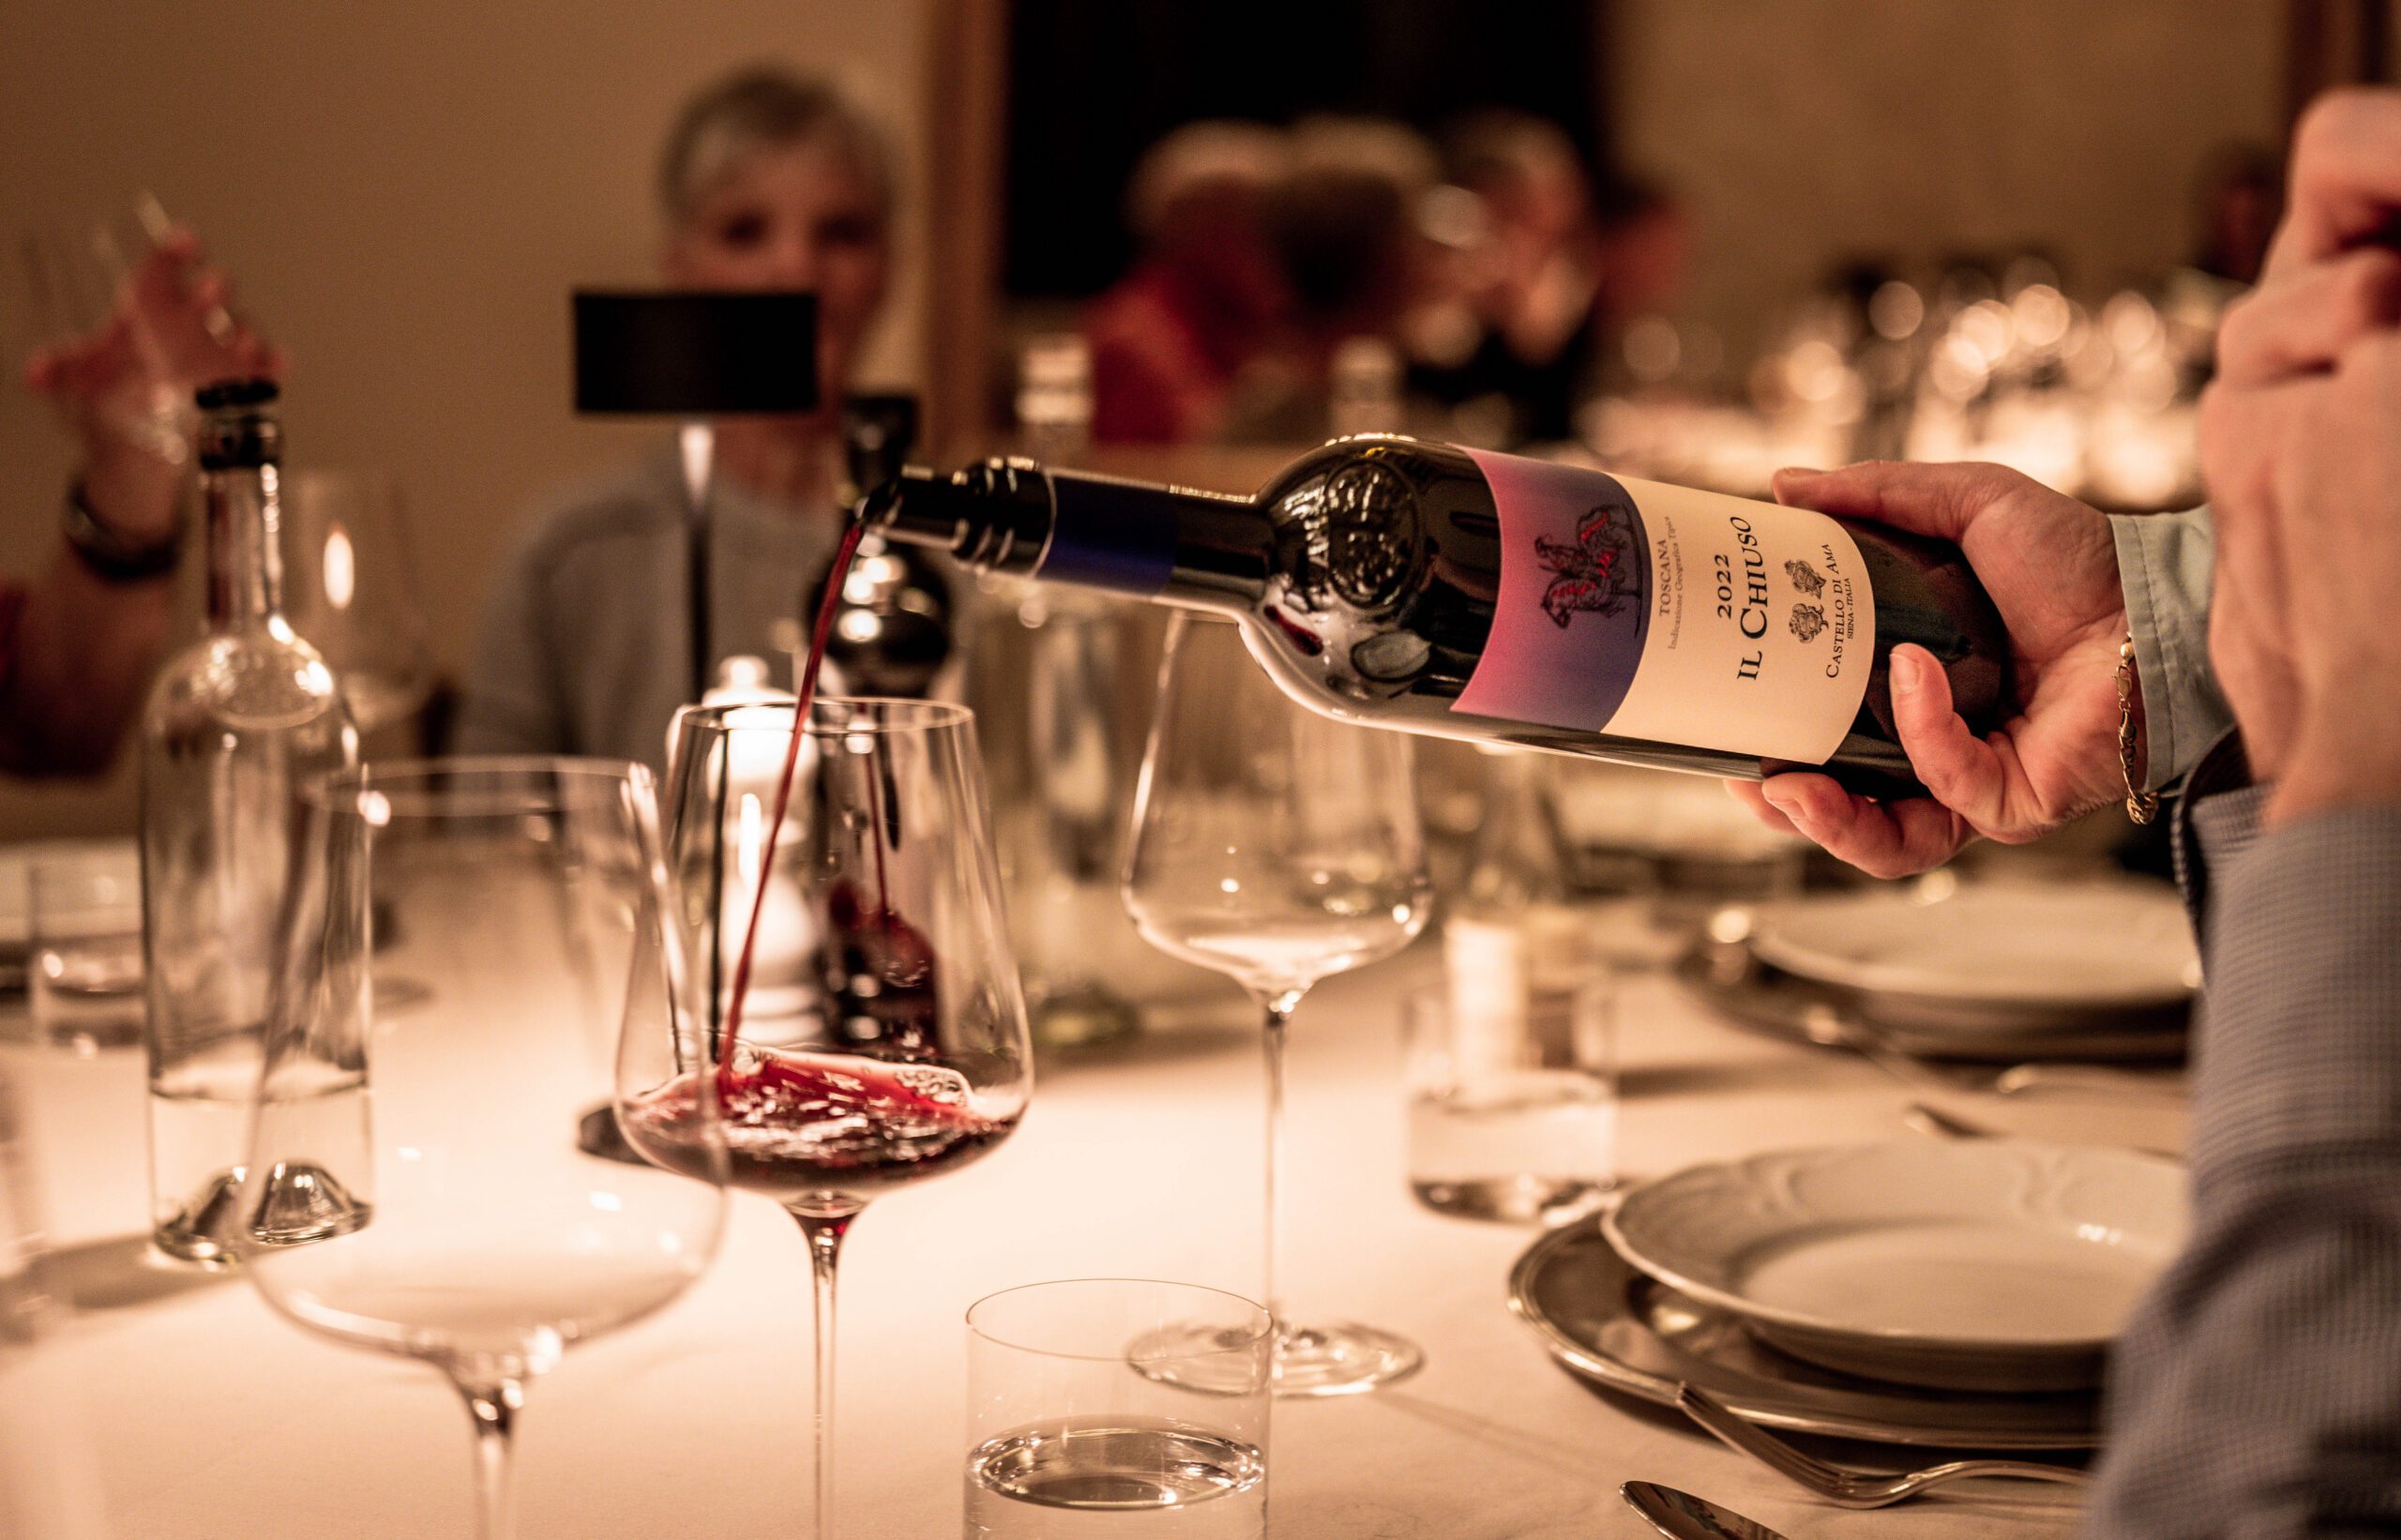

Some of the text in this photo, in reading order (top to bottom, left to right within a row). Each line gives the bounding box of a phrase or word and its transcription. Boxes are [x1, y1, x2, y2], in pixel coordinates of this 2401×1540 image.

[1656, 539, 1671, 616] TOSCANA
[1714, 554, 1732, 620] 2022
[1729, 516, 1768, 681] IL CHIUSO
[1821, 544, 1845, 678] CASTELLO DI AMA
[1844, 578, 1854, 606] ITALIA
